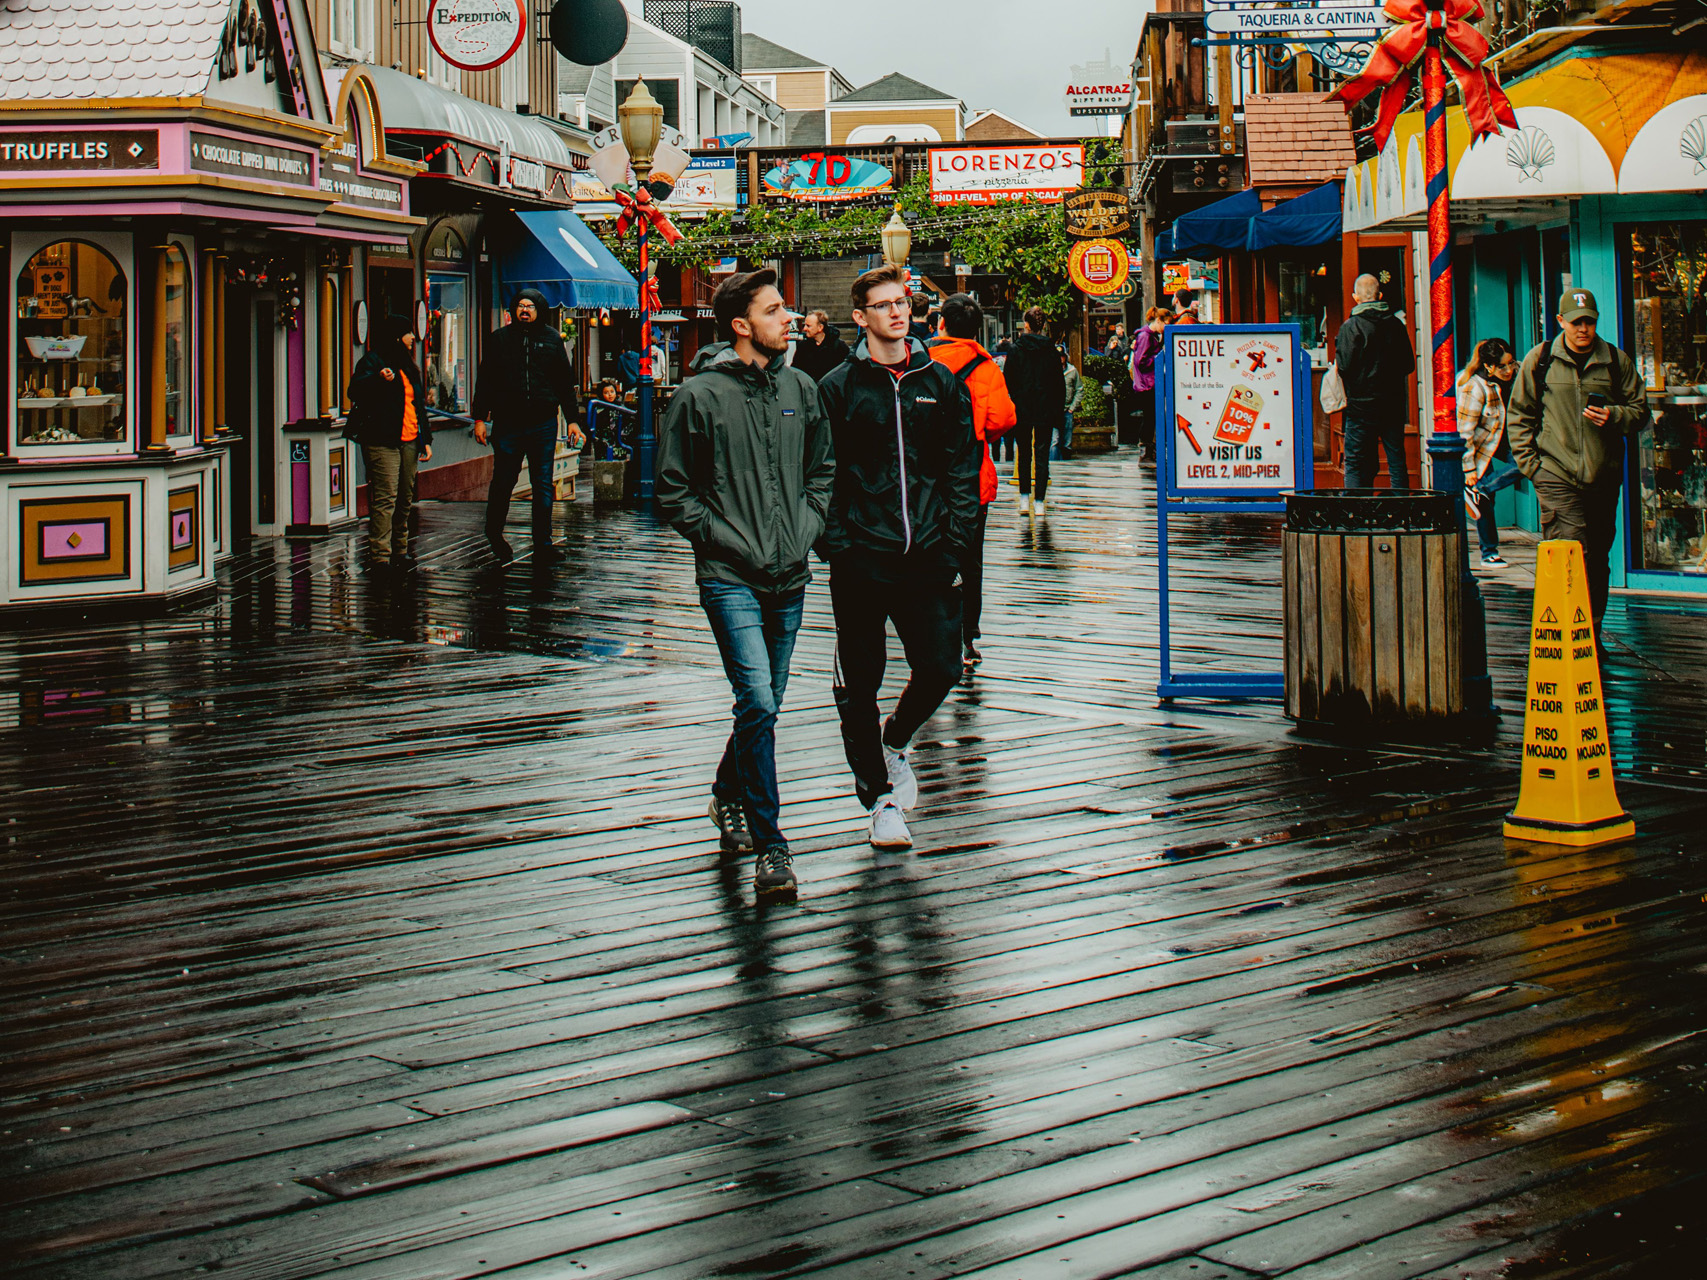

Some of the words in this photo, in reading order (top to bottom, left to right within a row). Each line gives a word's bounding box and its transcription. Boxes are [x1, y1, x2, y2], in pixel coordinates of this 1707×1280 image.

[1238, 13, 1300, 28] TAQUERIA
[1304, 12, 1313, 25] &
[1317, 11, 1375, 25] CANTINA
[1066, 83, 1131, 95] ALCATRAZ
[593, 126, 684, 149] CRES
[0, 142, 109, 161] TRUFFLES
[202, 144, 241, 165] CHOCOLATE
[241, 151, 263, 169] DIPPED
[264, 155, 278, 171] MINI
[279, 158, 302, 175] DONUTS
[938, 150, 1073, 172] LORENZO'S
[801, 152, 851, 186] 7D
[984, 177, 1030, 188] pizzeria
[933, 193, 952, 202] 2ND
[954, 192, 987, 202] LEVEL,
[989, 192, 1009, 202] TOP
[1010, 191, 1024, 200] OF
[1066, 205, 1129, 218] WILDER
[1075, 215, 1119, 226] WEST
[1074, 238, 1102, 256] CABLE
[1105, 238, 1123, 255] CAR
[1082, 281, 1116, 292] STORE
[1573, 293, 1587, 307] T
[1178, 339, 1225, 357] SOLVE
[1236, 340, 1257, 354] PUZZLES
[1262, 340, 1280, 353] GAMES
[1193, 361, 1211, 378] IT!
[1263, 371, 1276, 380] TOYS
[1193, 381, 1201, 389] Out
[1215, 381, 1224, 389] Box
[1229, 407, 1254, 424] 10%
[1209, 445, 1243, 460] VISIT
[1245, 445, 1262, 460] US
[1187, 465, 1218, 478] LEVEL
[1220, 465, 1230, 480] 2,
[1233, 464, 1281, 478] MID-PIER
[1534, 628, 1562, 641] CAUTION
[1571, 627, 1591, 641] CAUTION
[1534, 646, 1562, 660] CUIDADO
[1572, 645, 1592, 660] CUIDADO
[1536, 681, 1558, 695] WET
[1576, 681, 1593, 696] WET
[1530, 699, 1563, 714] FLOOR
[1574, 698, 1598, 714] FLOOR
[1535, 726, 1558, 741] PISO
[1581, 726, 1598, 742] PISO
[1526, 744, 1567, 760] MOJADO
[1576, 742, 1606, 761] MOJADO
